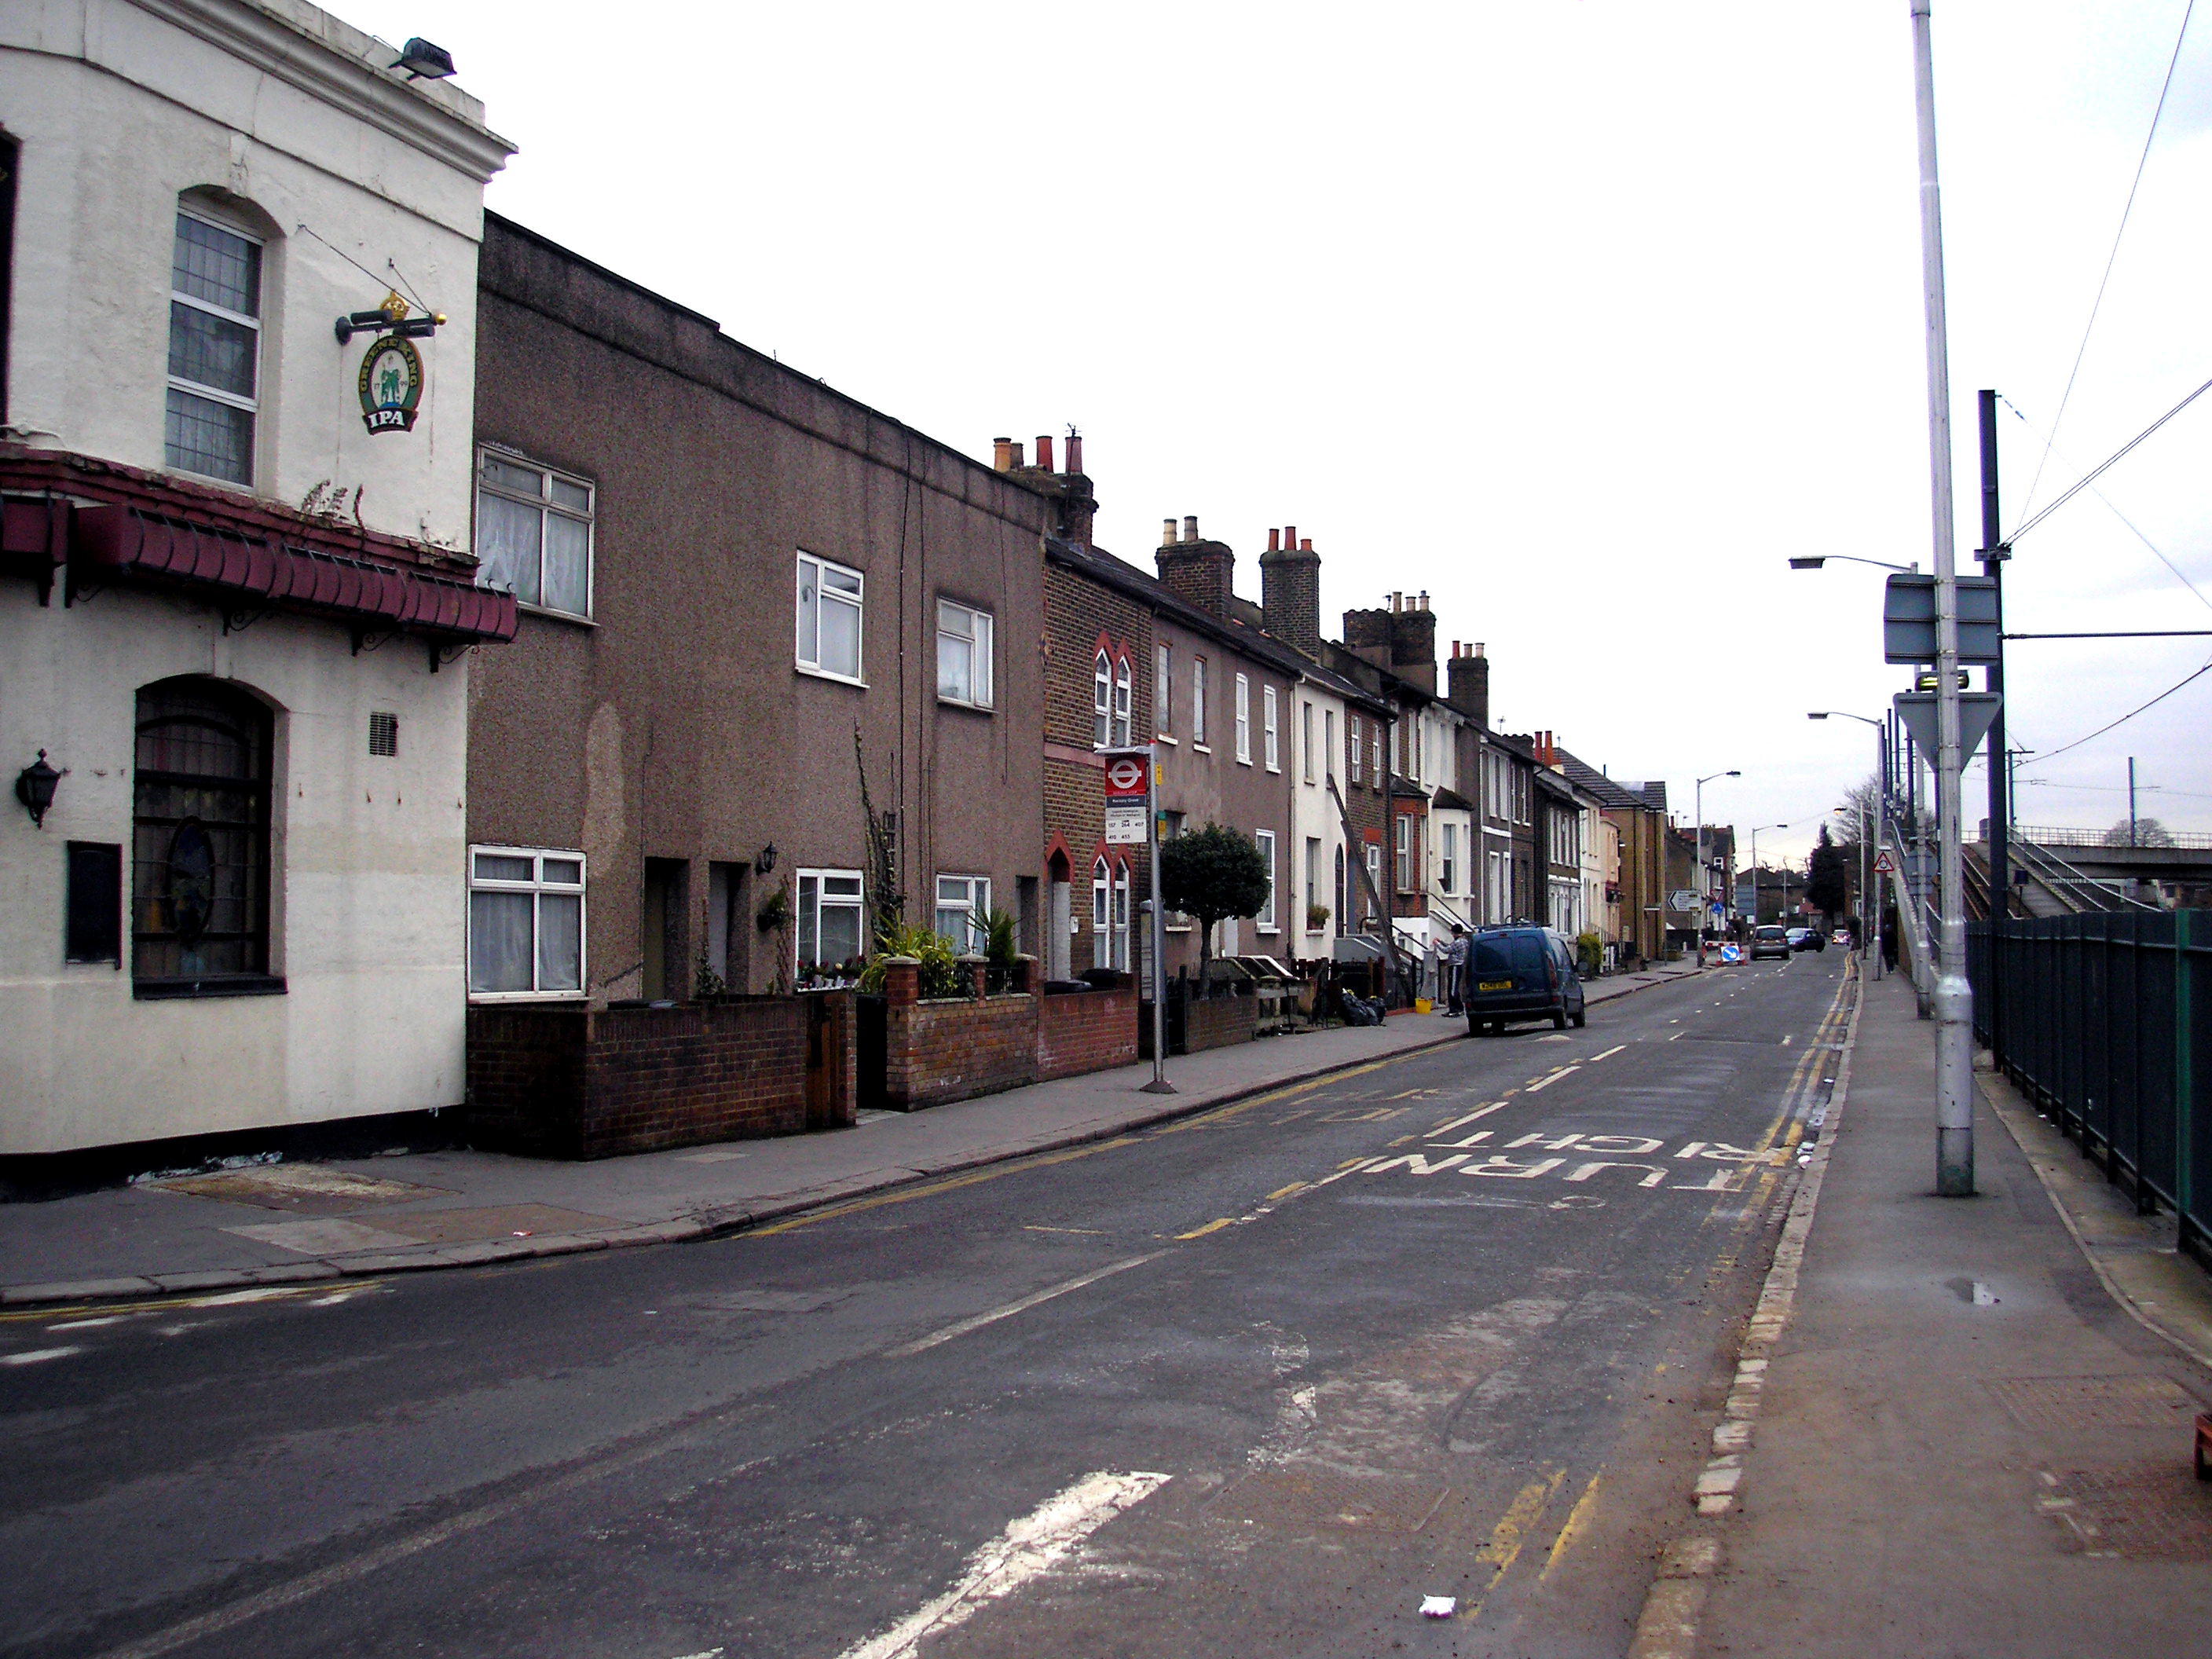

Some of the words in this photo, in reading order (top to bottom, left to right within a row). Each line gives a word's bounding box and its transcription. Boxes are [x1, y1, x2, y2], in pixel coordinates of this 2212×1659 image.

[368, 410, 405, 428] IPA
[1422, 1130, 1780, 1163] RIGHT
[1361, 1154, 1742, 1192] TURN
